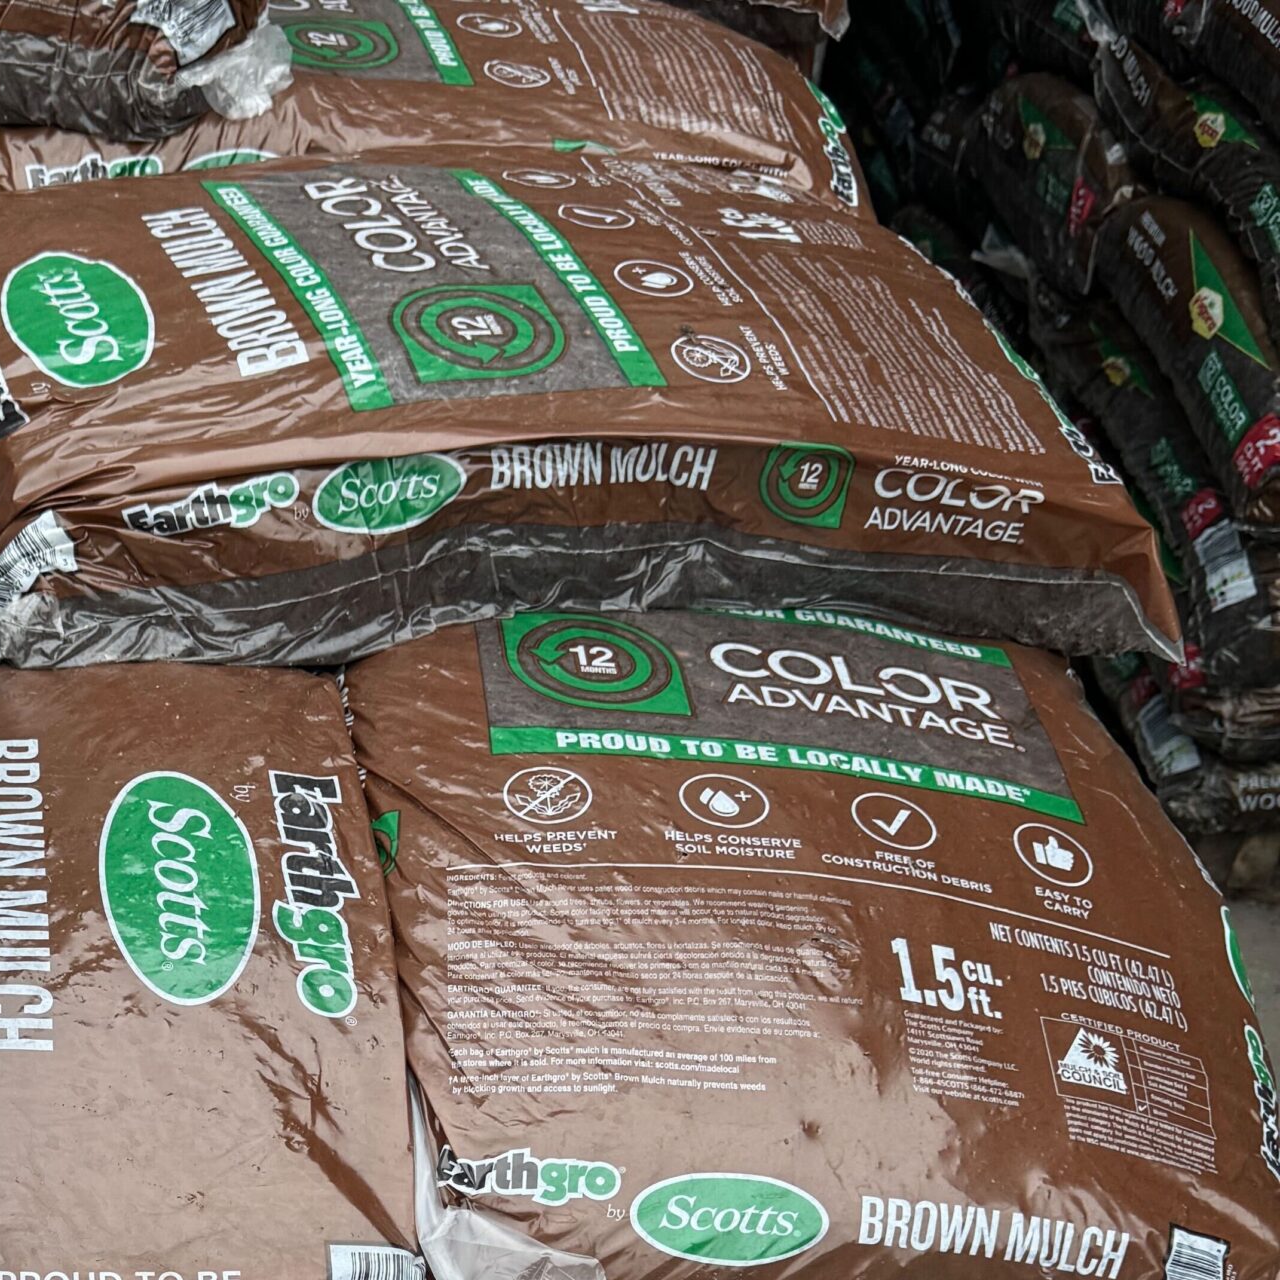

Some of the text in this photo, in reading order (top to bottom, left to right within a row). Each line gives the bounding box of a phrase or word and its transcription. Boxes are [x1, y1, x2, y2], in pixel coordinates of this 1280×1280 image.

[305, 177, 436, 272] COLOR
[549, 253, 579, 273] BE
[567, 274, 590, 291] TO
[141, 207, 309, 377] BROWN MULCH
[585, 296, 639, 353] PROUD
[122, 472, 299, 536] Earthgro
[337, 470, 439, 514] Scotts
[491, 442, 602, 491] BROWN
[611, 442, 718, 491] MULCH
[800, 462, 824, 484] 12
[875, 468, 1045, 514] COLOR
[569, 645, 616, 668] 12
[710, 643, 1000, 719] COLOR
[556, 731, 671, 754] PROUD
[681, 739, 725, 757] TO
[735, 744, 779, 763] BE
[789, 747, 923, 783] LOCALLY
[232, 784, 256, 803] by
[664, 831, 802, 848] HELPS CONSERVE
[676, 843, 796, 859] SOIL MOISTURE
[146, 798, 211, 966] Scotts
[269, 770, 361, 1019] Earthgro
[891, 937, 1004, 1012] 1.5 cu.
[967, 985, 1004, 1020] ft.
[437, 1148, 1131, 1280] Earthgro by Scotts BROWN MULCH
